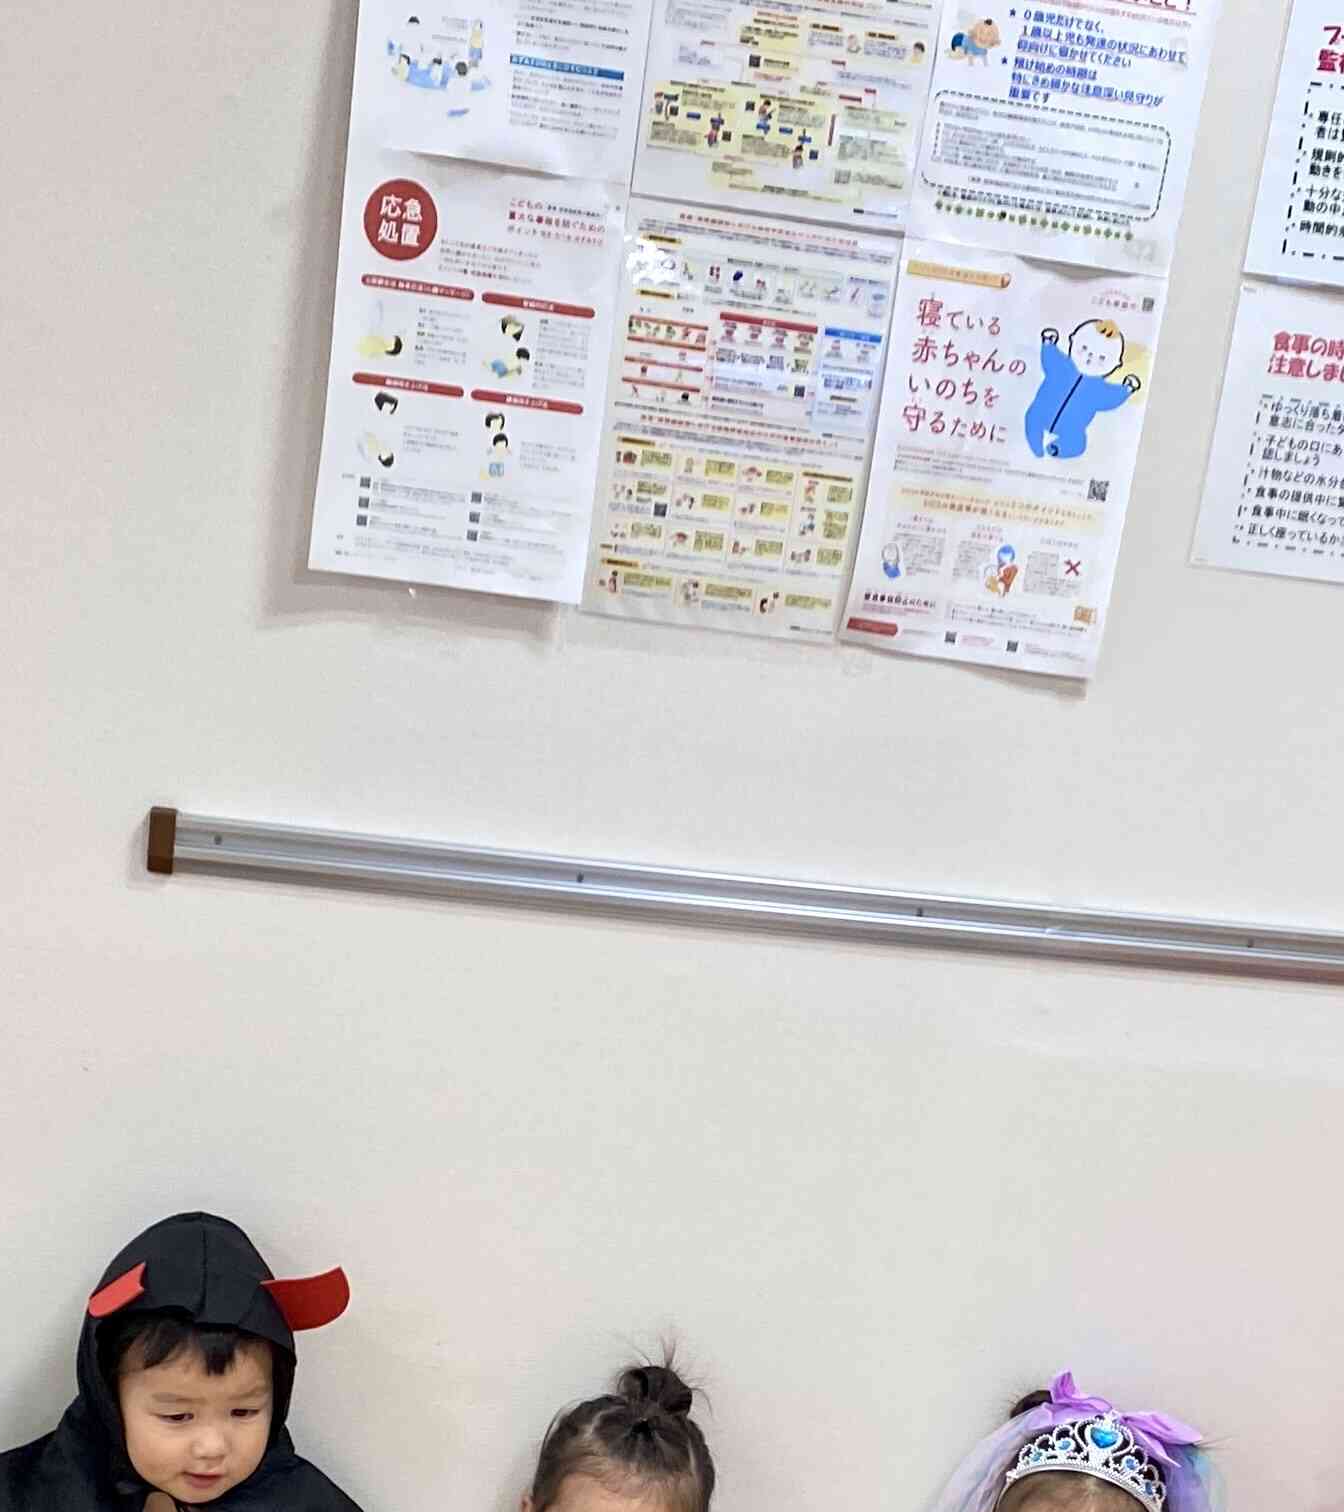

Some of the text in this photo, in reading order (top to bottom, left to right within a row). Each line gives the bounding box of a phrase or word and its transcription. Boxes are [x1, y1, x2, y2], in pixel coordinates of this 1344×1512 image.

[379, 194, 423, 222] 応急
[377, 221, 422, 247] 処置
[916, 297, 1002, 337] 寝ている
[912, 336, 1027, 376] 赤ちゃんの
[908, 374, 1001, 409] いのちを
[902, 403, 1007, 443] 守るために
